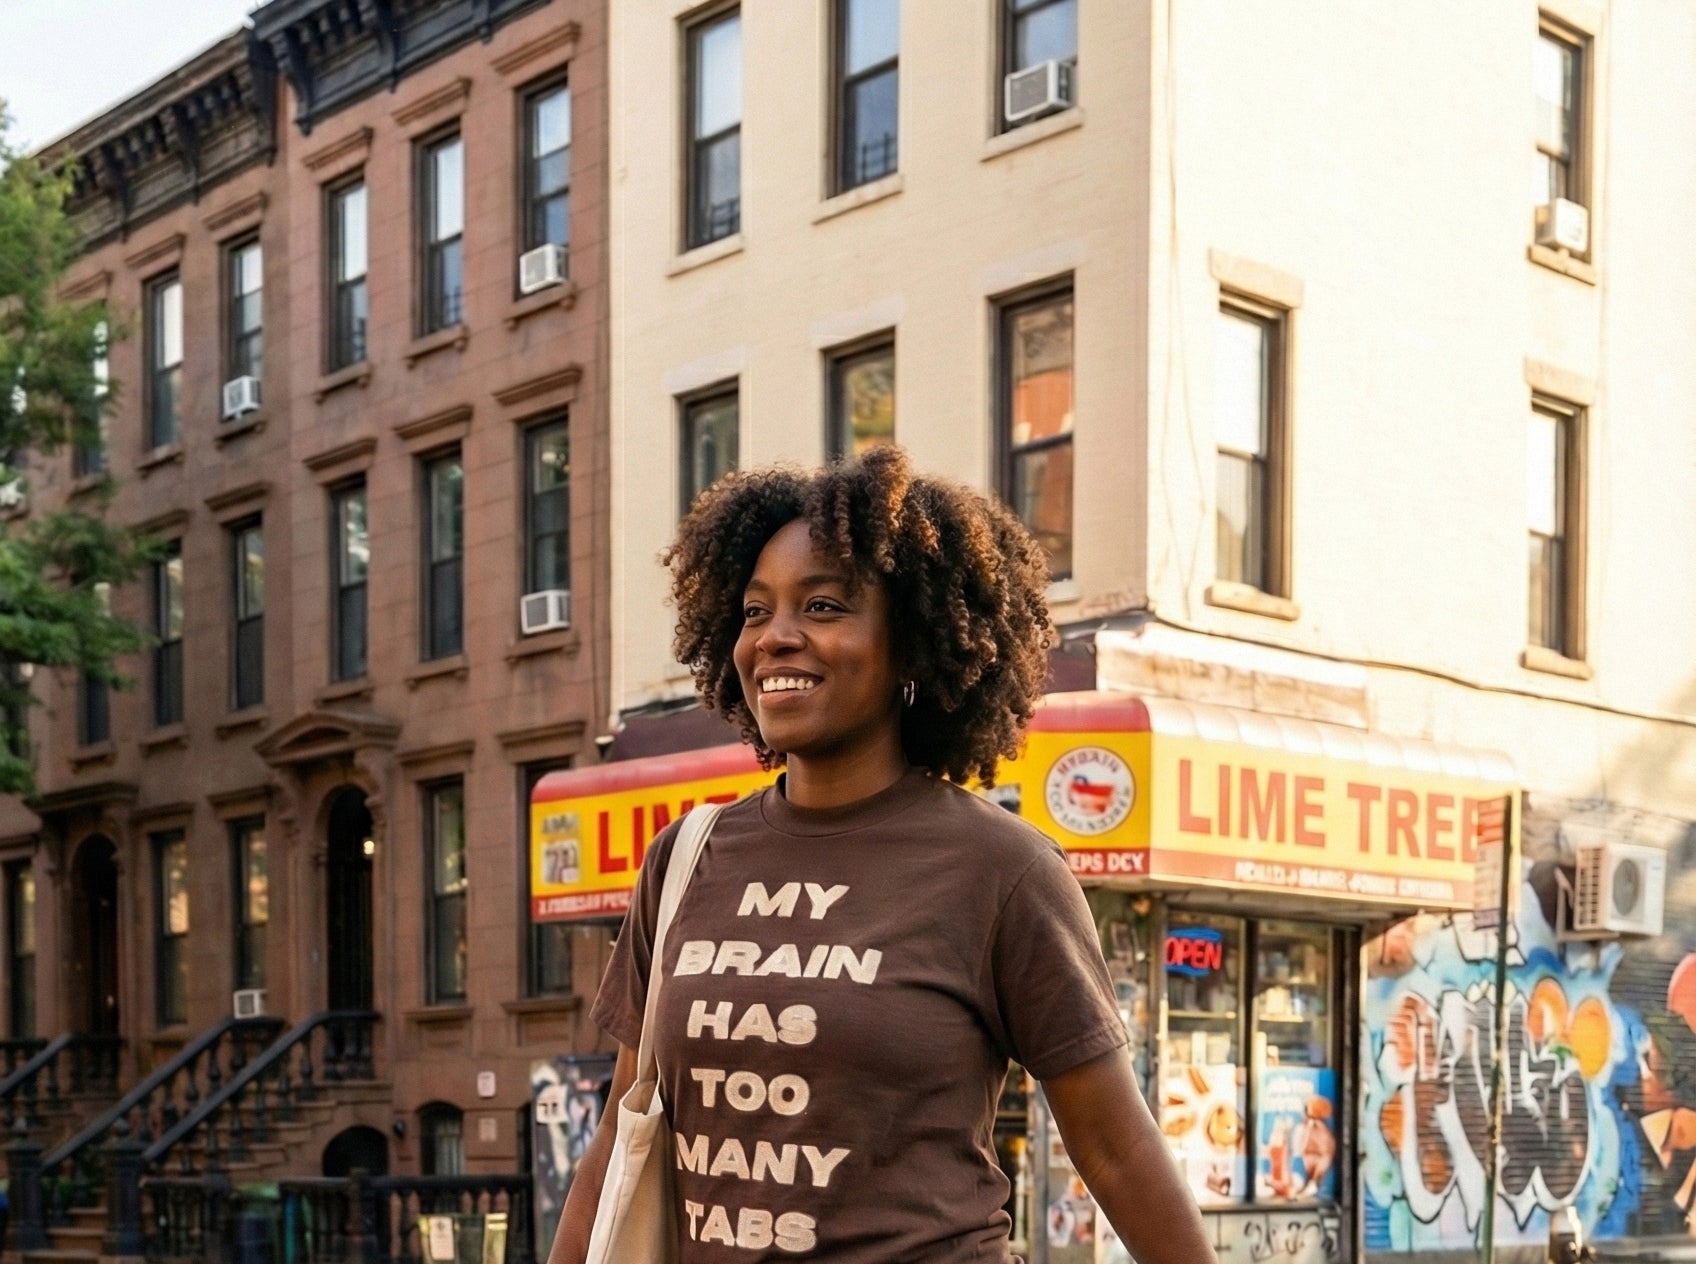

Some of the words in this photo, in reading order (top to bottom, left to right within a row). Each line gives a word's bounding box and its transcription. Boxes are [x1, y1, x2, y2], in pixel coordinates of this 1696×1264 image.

[1178, 759, 1326, 848] LIME
[736, 881, 851, 920] MY
[672, 940, 884, 985] BRAIN
[1164, 936, 1222, 970] OPEN
[686, 1000, 818, 1045] HAS
[690, 1067, 811, 1116] TOO
[674, 1131, 852, 1188] MANY
[684, 1198, 818, 1252] TABS
